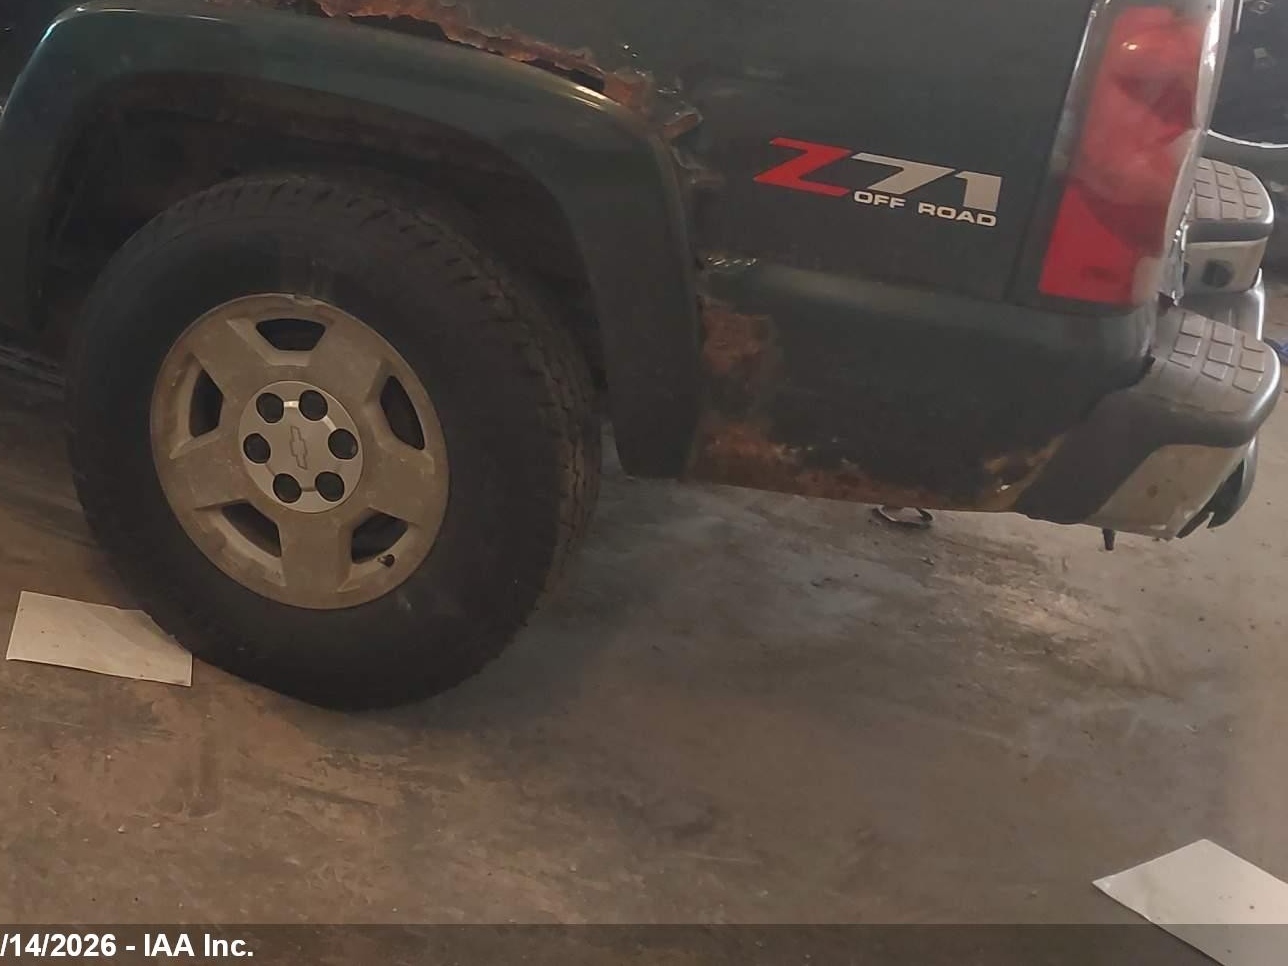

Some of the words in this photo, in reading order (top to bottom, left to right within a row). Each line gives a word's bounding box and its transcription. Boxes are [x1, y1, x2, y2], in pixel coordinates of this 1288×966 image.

[753, 137, 1002, 212] Z71
[853, 190, 906, 209] OFF
[918, 202, 998, 227] ROAD
